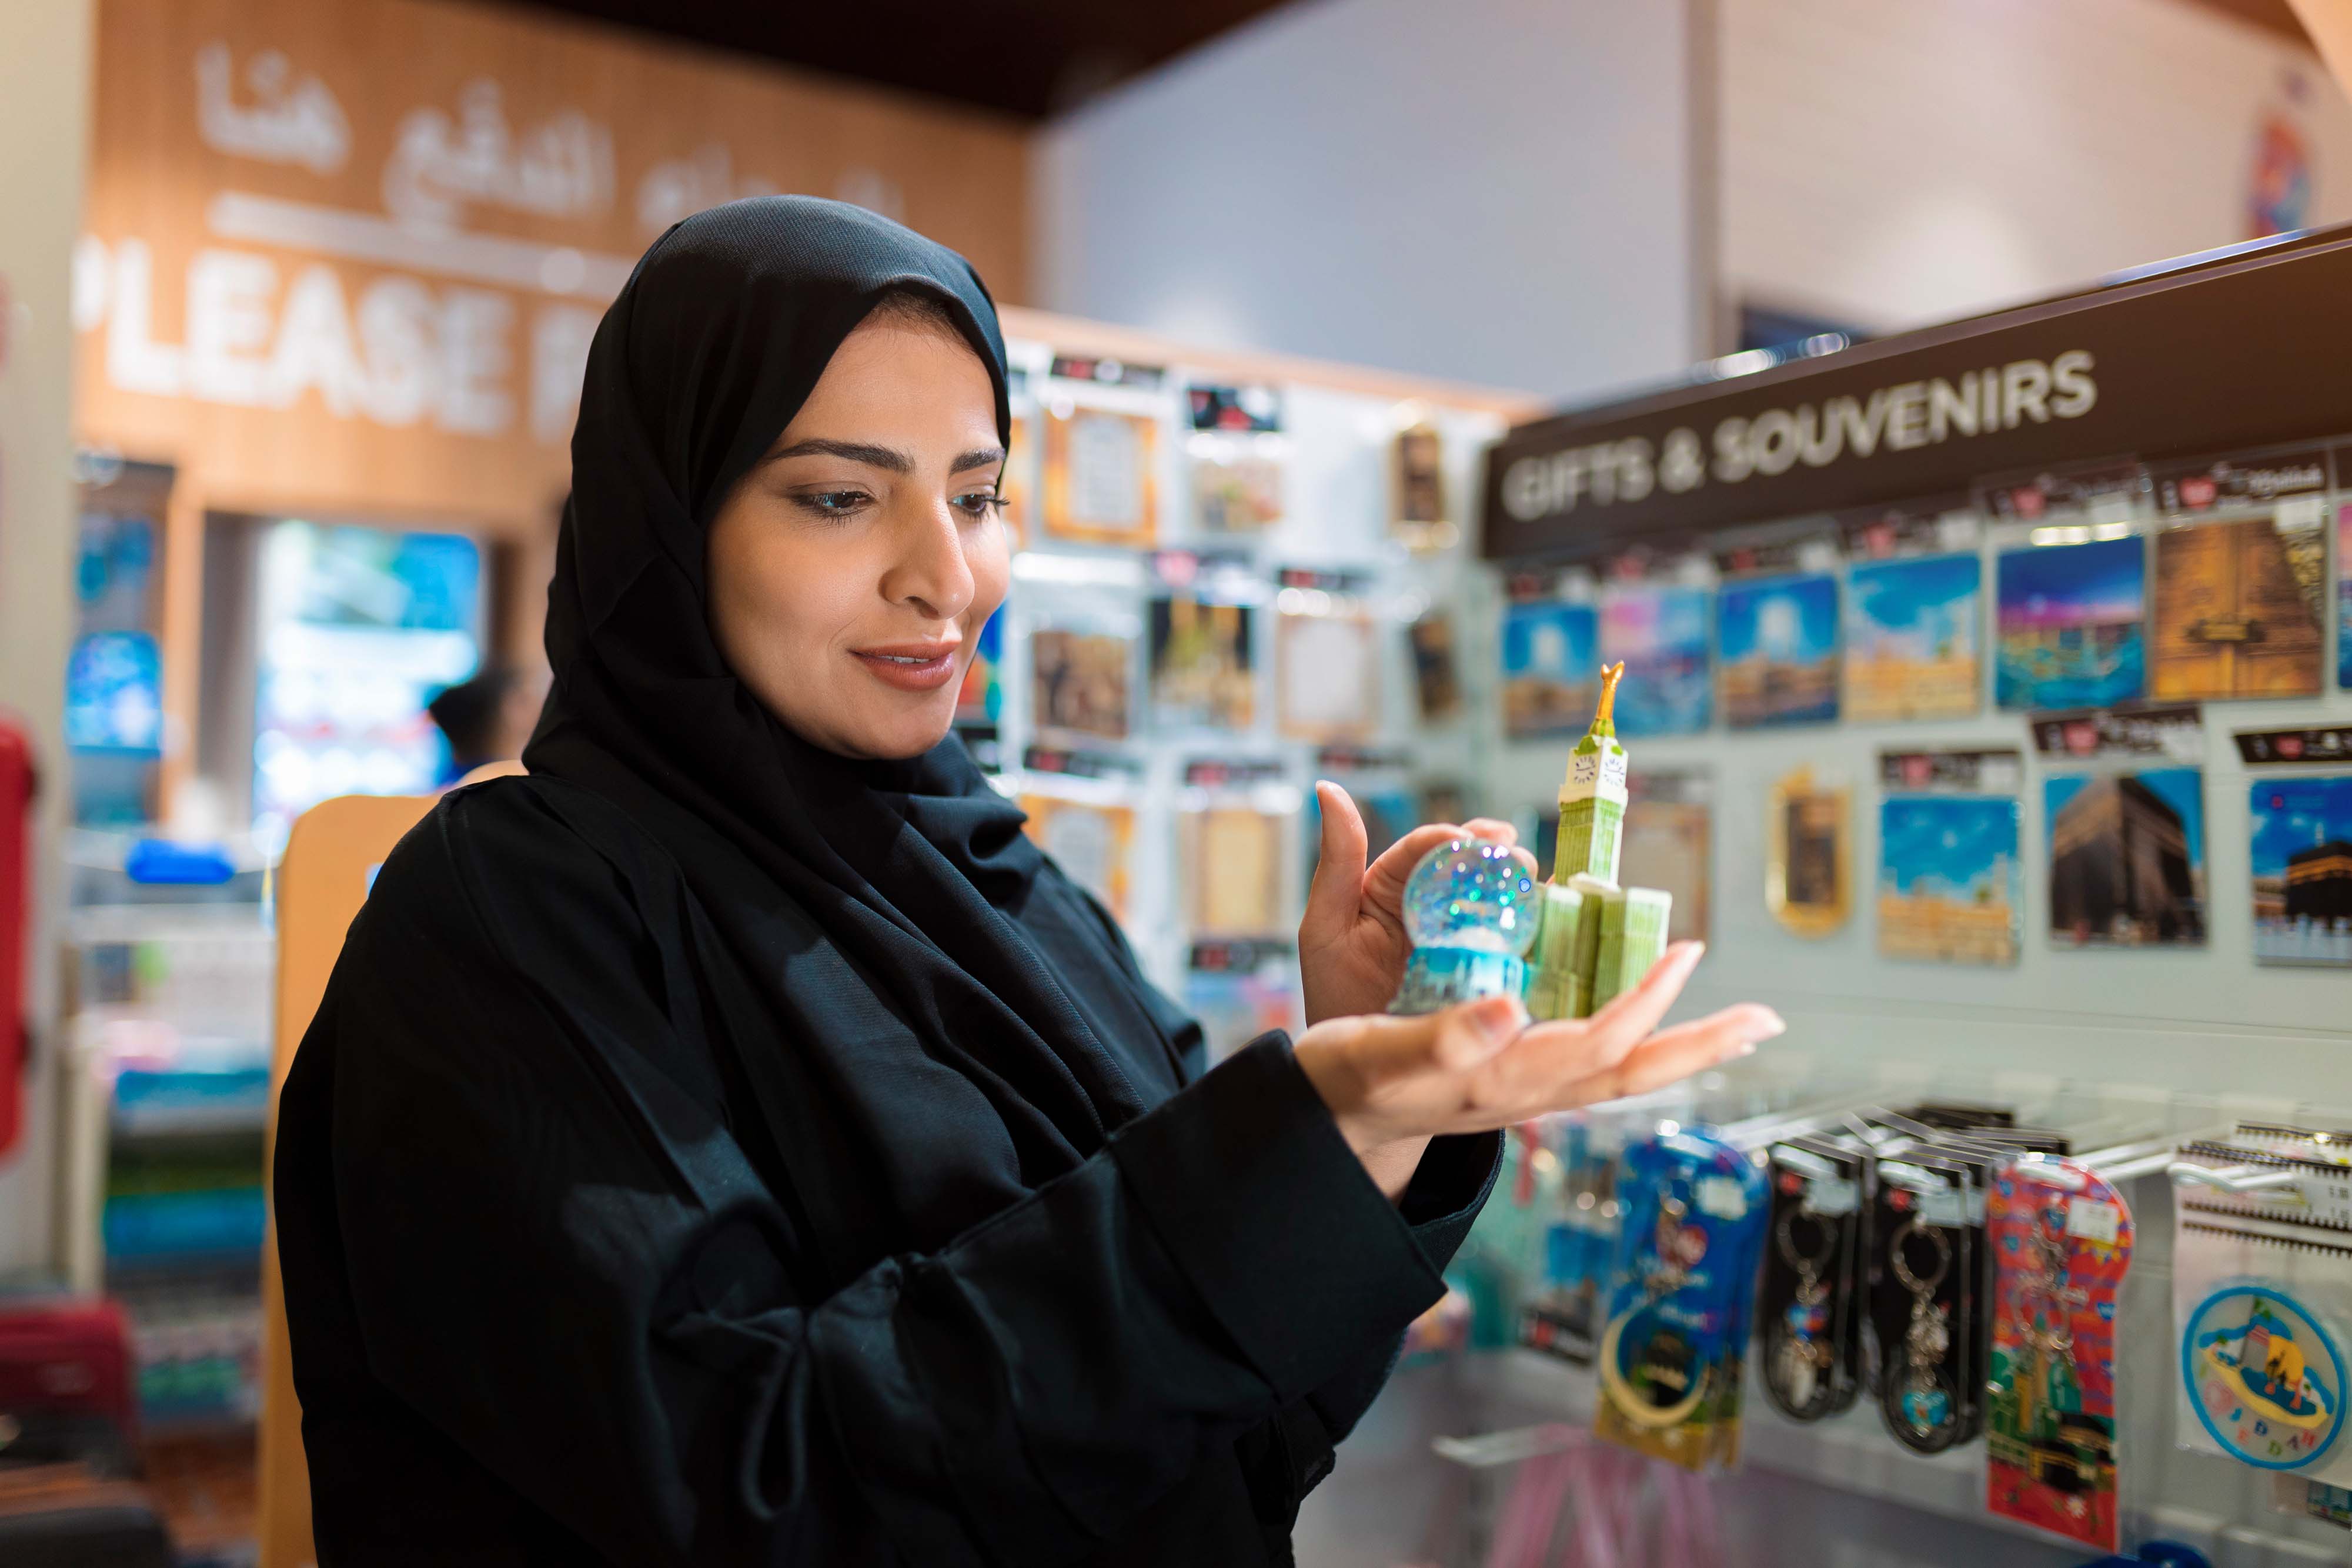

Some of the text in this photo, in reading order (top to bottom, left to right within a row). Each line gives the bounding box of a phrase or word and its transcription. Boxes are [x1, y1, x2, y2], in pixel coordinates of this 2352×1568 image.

[1502, 351, 2097, 520] GIFTS & SOUVENIRS
